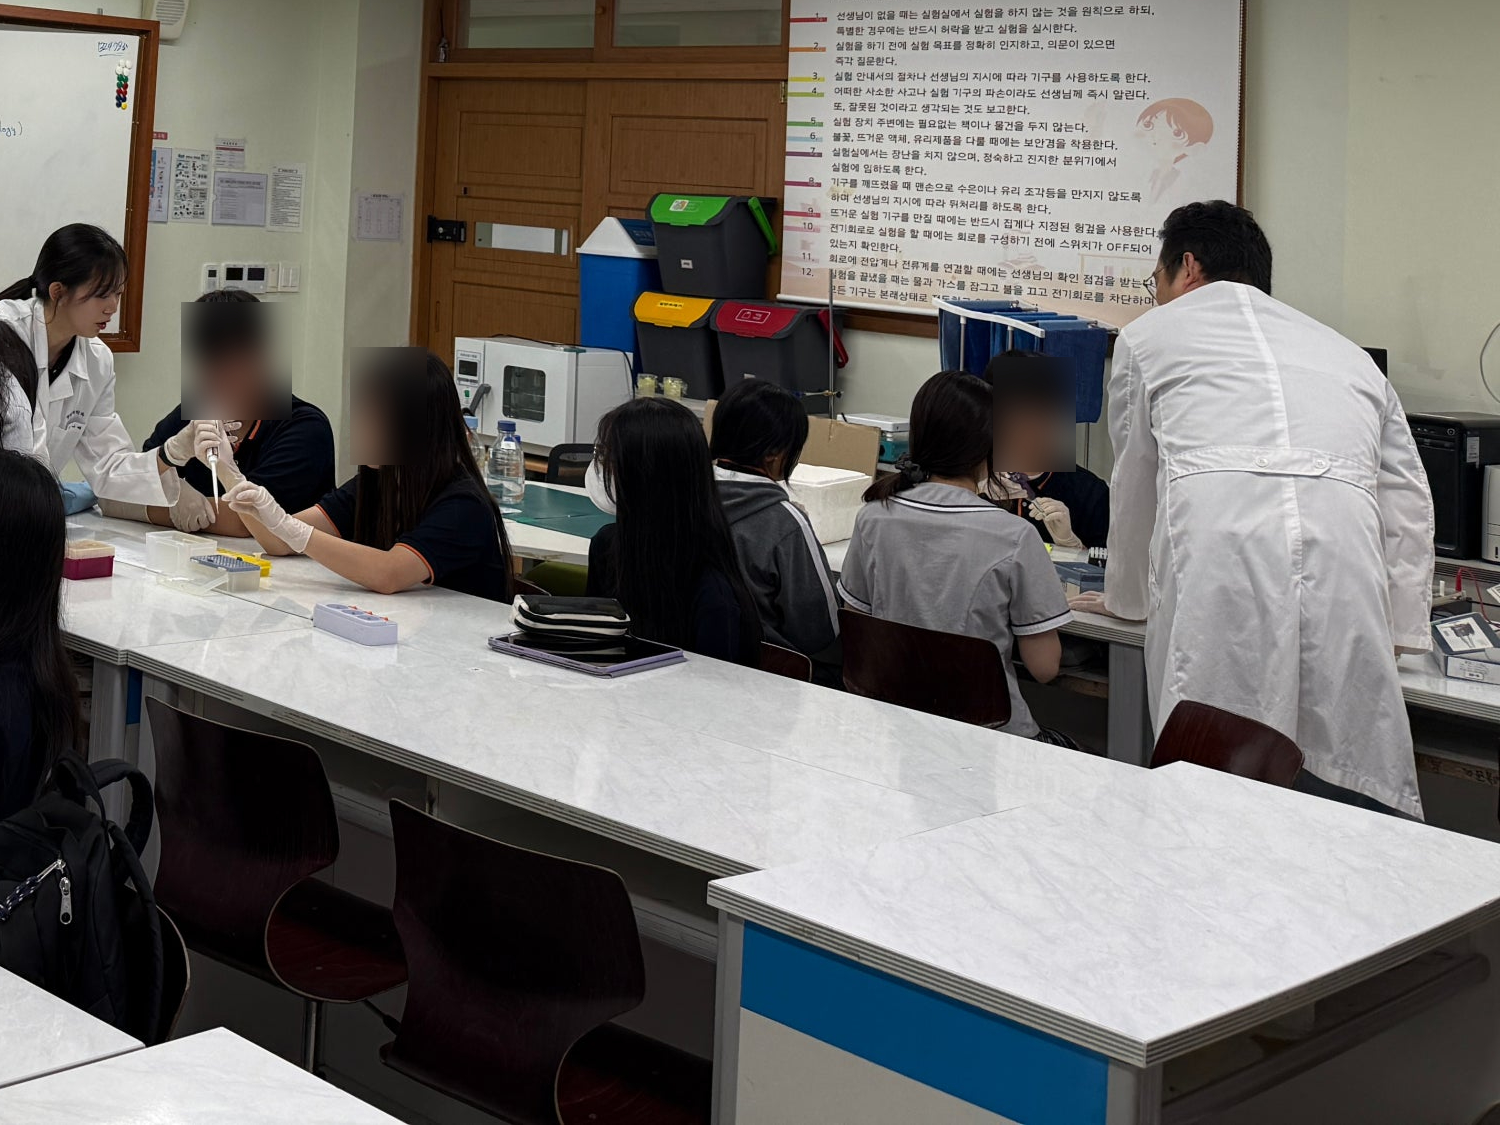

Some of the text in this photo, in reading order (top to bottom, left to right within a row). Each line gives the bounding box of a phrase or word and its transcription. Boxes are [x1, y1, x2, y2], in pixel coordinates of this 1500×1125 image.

[836, 10, 874, 21] 선생님이
[876, 10, 896, 21] 없을
[898, 10, 919, 20] 때는
[921, 9, 970, 20] 실험실에서
[973, 7, 1005, 19] 실험을
[1007, 7, 1028, 18] 하지
[1031, 7, 1054, 18] 않는
[1056, 6, 1078, 18] 것을
[1081, 5, 1125, 17] 원칙으로
[836, 23, 1077, 37] 특별한 경우에는 반드시 허락을 받고 실험을 실시한다.
[835, 41, 864, 52] 실험을
[866, 41, 885, 51] 하기
[888, 40, 907, 51] 전에
[910, 40, 930, 51] 실험
[932, 40, 963, 51] 목표를
[965, 40, 996, 51] 정확히
[1047, 39, 1079, 50] 의문이
[1083, 39, 1115, 50] 있으면
[835, 56, 898, 67] 즉각 질문한다.
[834, 71, 1151, 84] 실험 안내서의 절차나 선생님의 지시에 따라 기구를 사용하도록 한다.
[833, 117, 1089, 133] 실험 장치 주변에는 필요없는 책이나 물건을 두지 않는다.
[856, 133, 885, 144] 뜨거운
[913, 134, 963, 146] 유리제품을
[965, 136, 986, 147] 다룰
[989, 136, 1021, 148] 때에는
[1023, 138, 1067, 150] 보안경을
[1070, 138, 1118, 151] 착용한다.
[831, 147, 889, 159] 실험실에서는
[891, 149, 921, 161] 장난을
[924, 150, 943, 161] 치지
[983, 152, 1024, 164] 정숙하고
[1027, 154, 1060, 166] 진지한
[1062, 155, 1117, 168] 분위기에서
[831, 177, 1142, 203] 기구를 깨뜨렸을 때 맨손으로 수은이나 유리 조각등을 만지지 않도록
[830, 208, 858, 219] 뜨거운
[860, 210, 879, 221] 실험
[882, 211, 910, 223] 기구를
[913, 213, 933, 225] 만질
[936, 214, 967, 227] 때에는
[970, 216, 1000, 228] 반드시
[1003, 218, 1035, 230] 집게나
[1038, 221, 1070, 233] 지정된
[830, 223, 1152, 255] 전기회로로 실험을 할 때에는 회로를 구성하기 전에 스위치가 OFF되어
